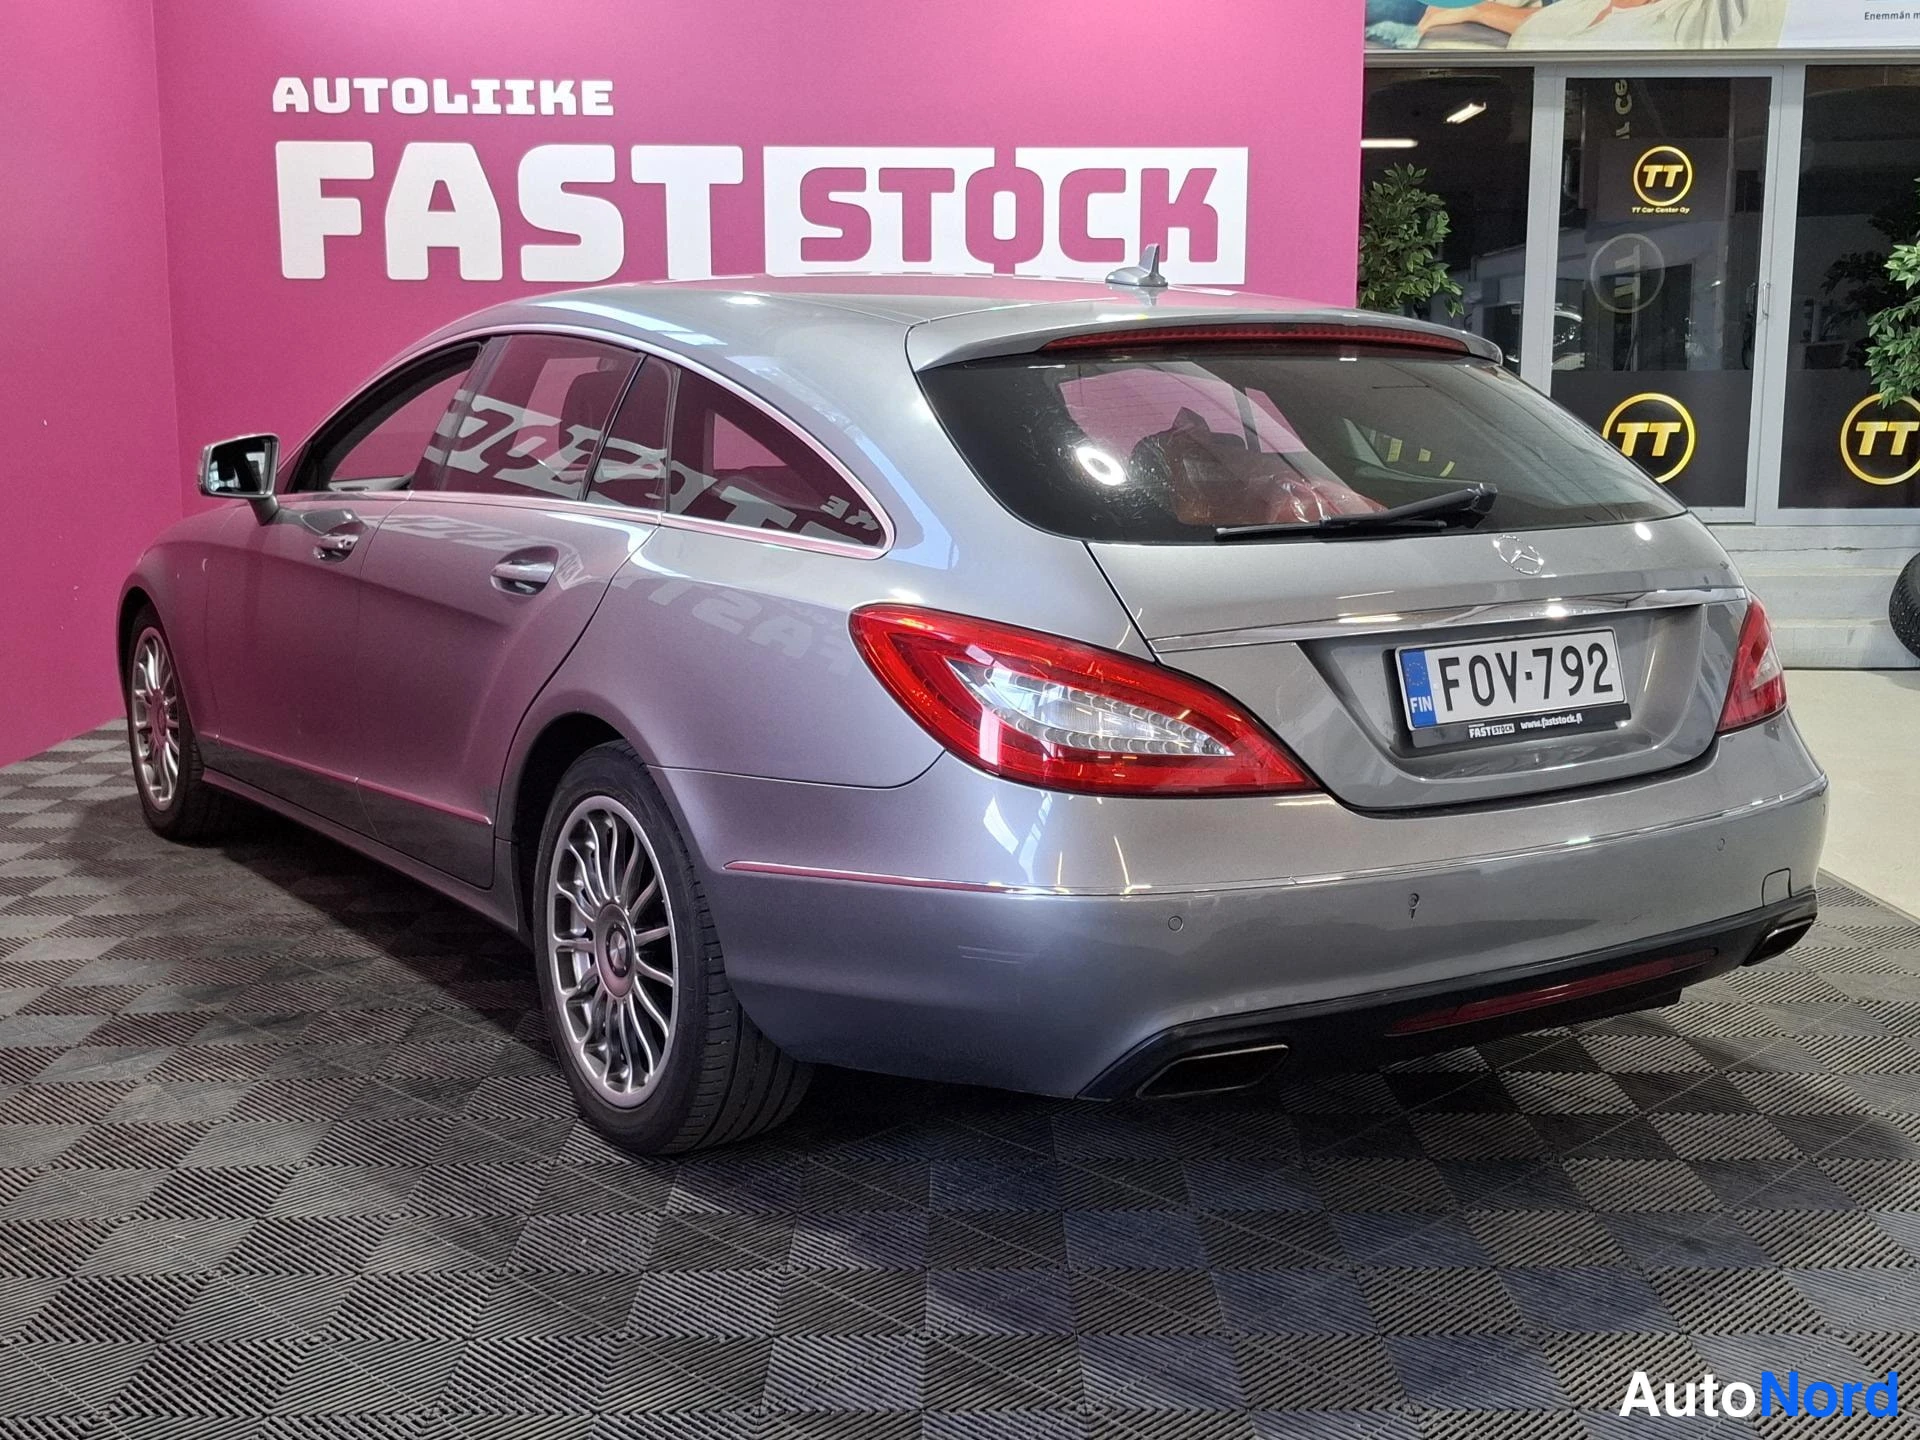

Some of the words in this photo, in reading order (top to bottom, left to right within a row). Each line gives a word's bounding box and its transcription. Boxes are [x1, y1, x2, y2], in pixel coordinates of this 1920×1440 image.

[272, 77, 614, 116] AUTOLIIKE
[1641, 164, 1684, 188] TT
[1632, 206, 1641, 214] TT
[1641, 206, 1655, 214] Car
[1655, 206, 1679, 214] Center
[1616, 421, 1681, 457] TT
[1855, 421, 1919, 456] TT
[1438, 642, 1614, 712] FOV-792
[1410, 694, 1433, 714] FIN
